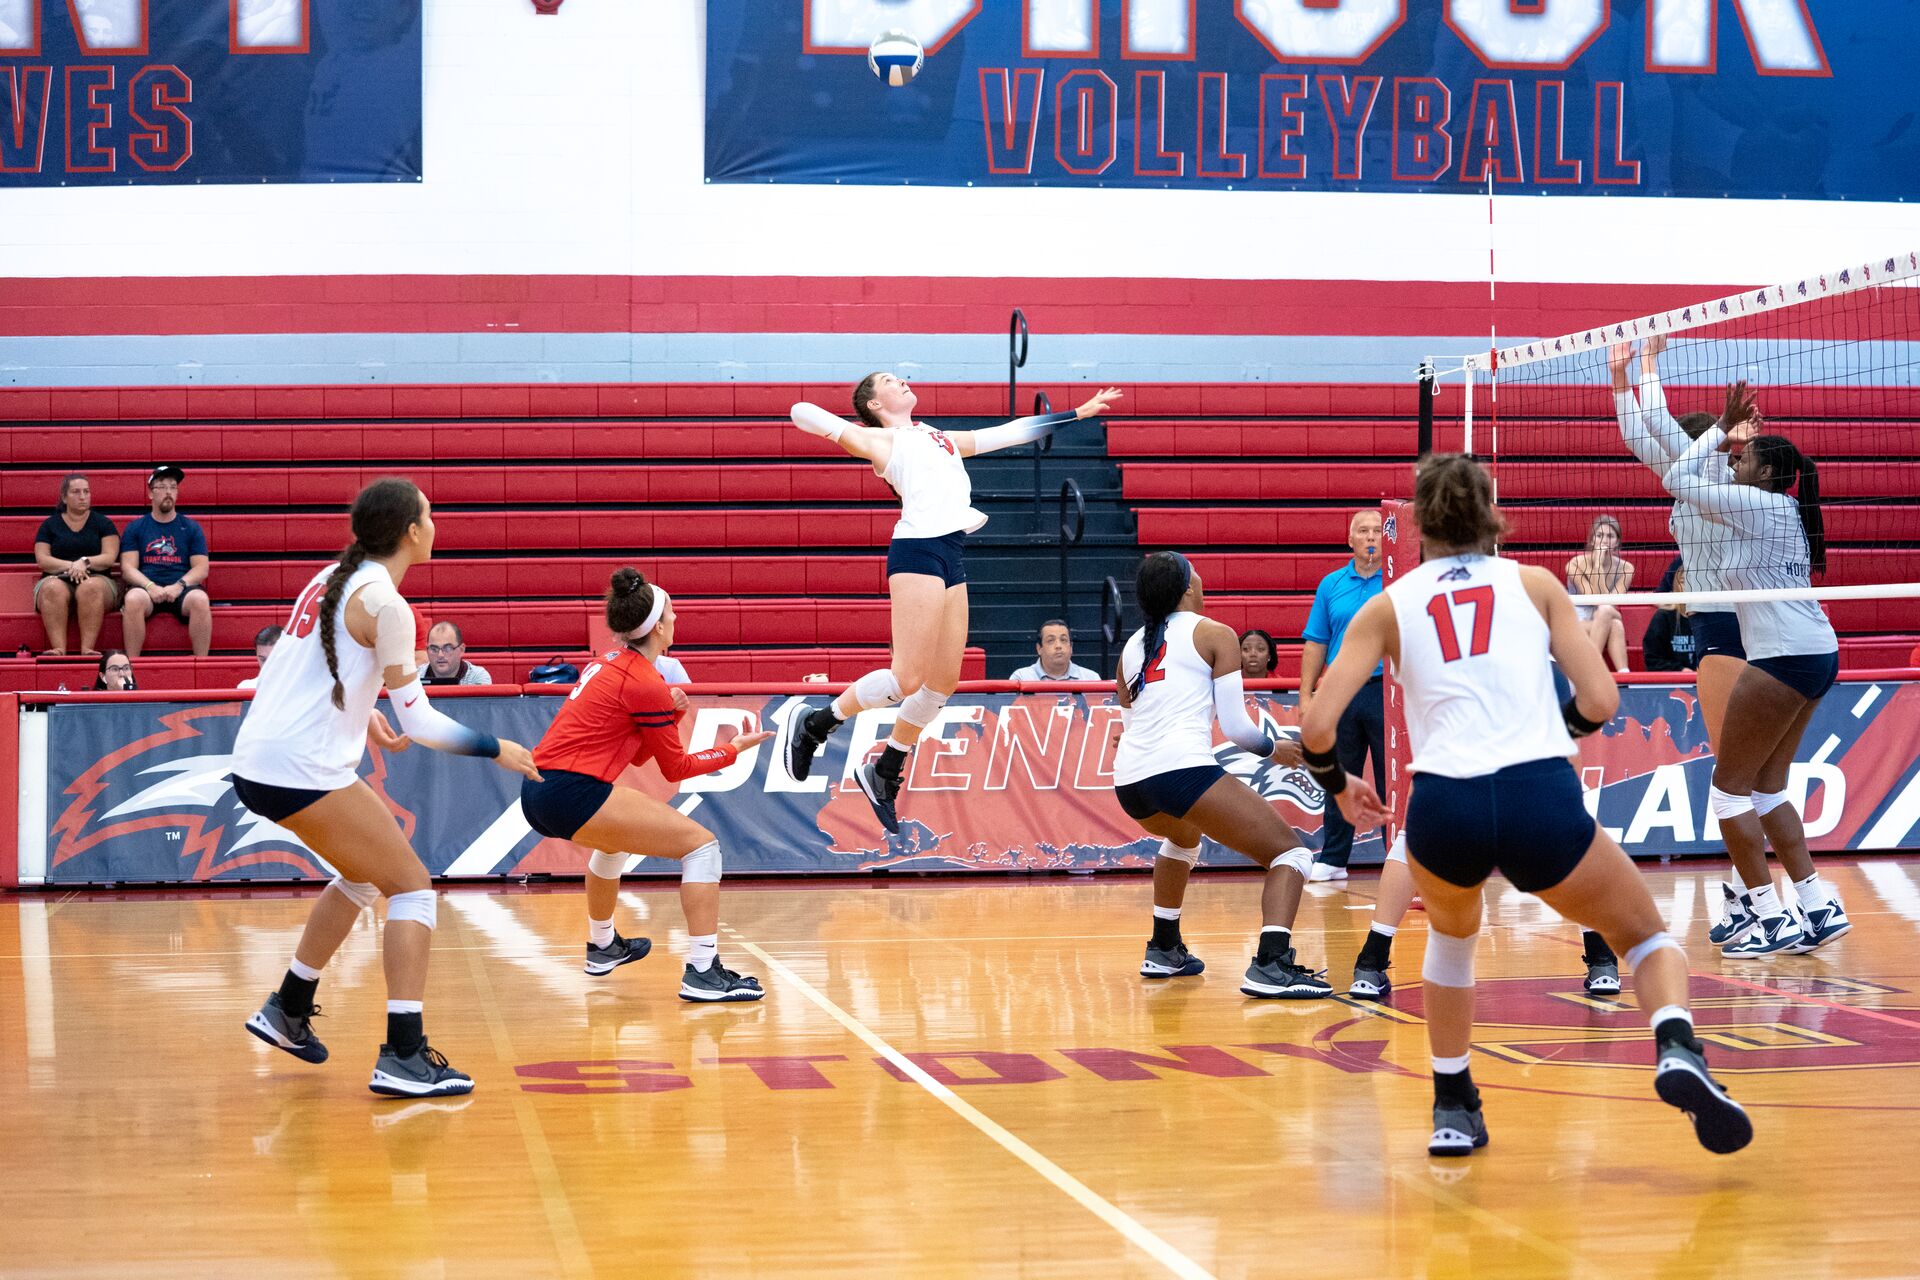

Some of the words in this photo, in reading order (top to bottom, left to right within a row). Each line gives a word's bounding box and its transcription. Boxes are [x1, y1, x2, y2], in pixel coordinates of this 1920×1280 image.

[978, 68, 1641, 185] VOLLEYBALL
[286, 583, 328, 638] 15
[1426, 584, 1495, 663] 17
[679, 704, 1124, 793] DEFEND
[165, 831, 181, 841] TM
[514, 1038, 1409, 1095] STONY
